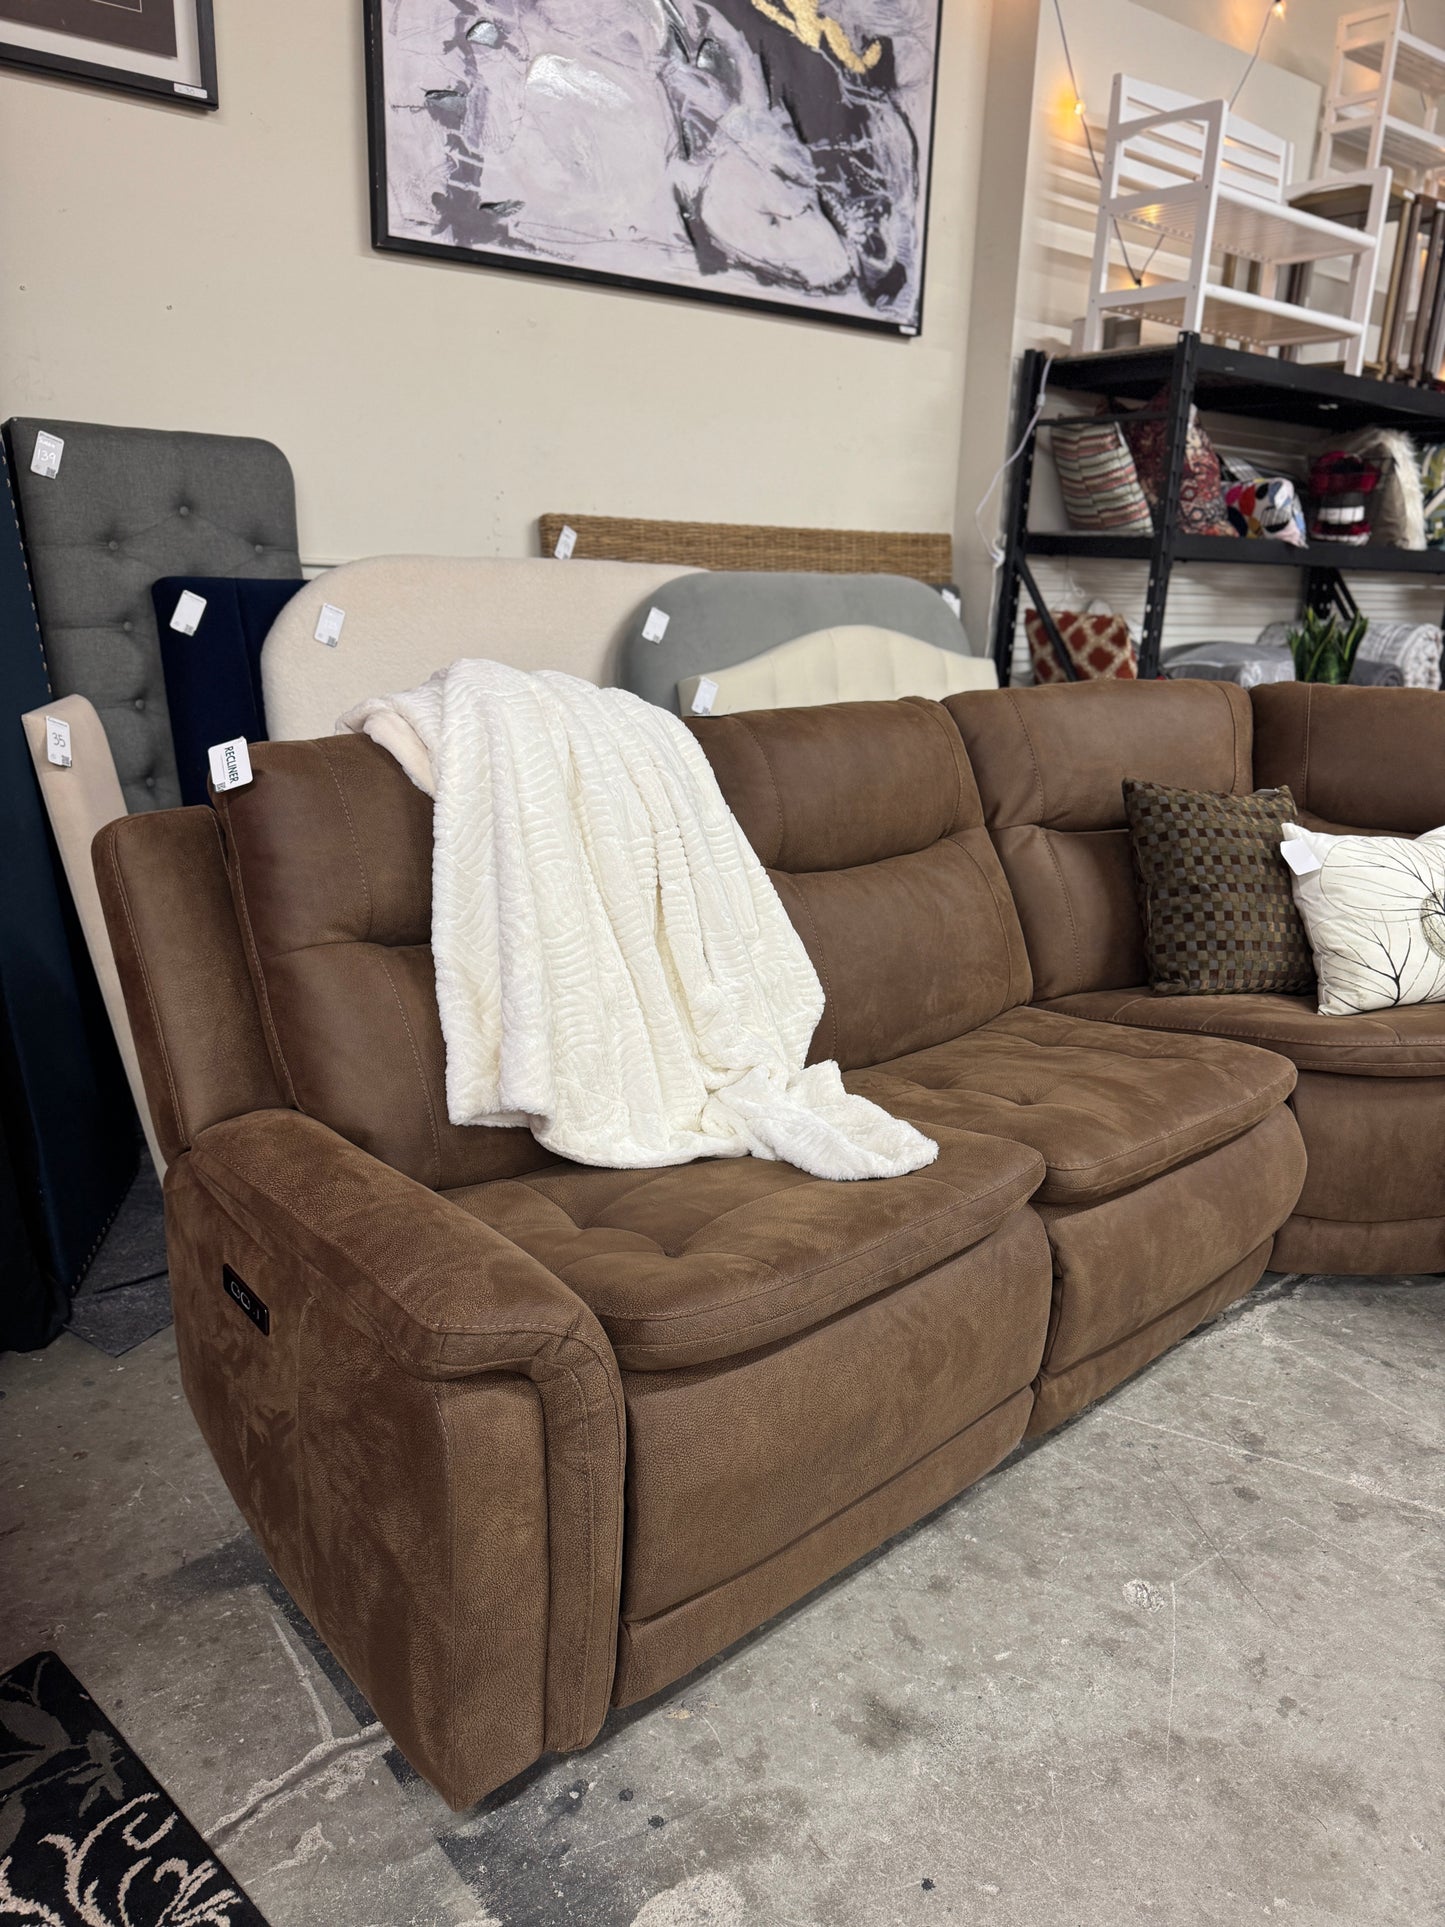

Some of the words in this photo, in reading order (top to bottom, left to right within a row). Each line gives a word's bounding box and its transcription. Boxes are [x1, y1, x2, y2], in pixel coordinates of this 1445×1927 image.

[37, 449, 57, 465] 139
[52, 732, 66, 748] 35
[224, 745, 240, 784] RECLINER
